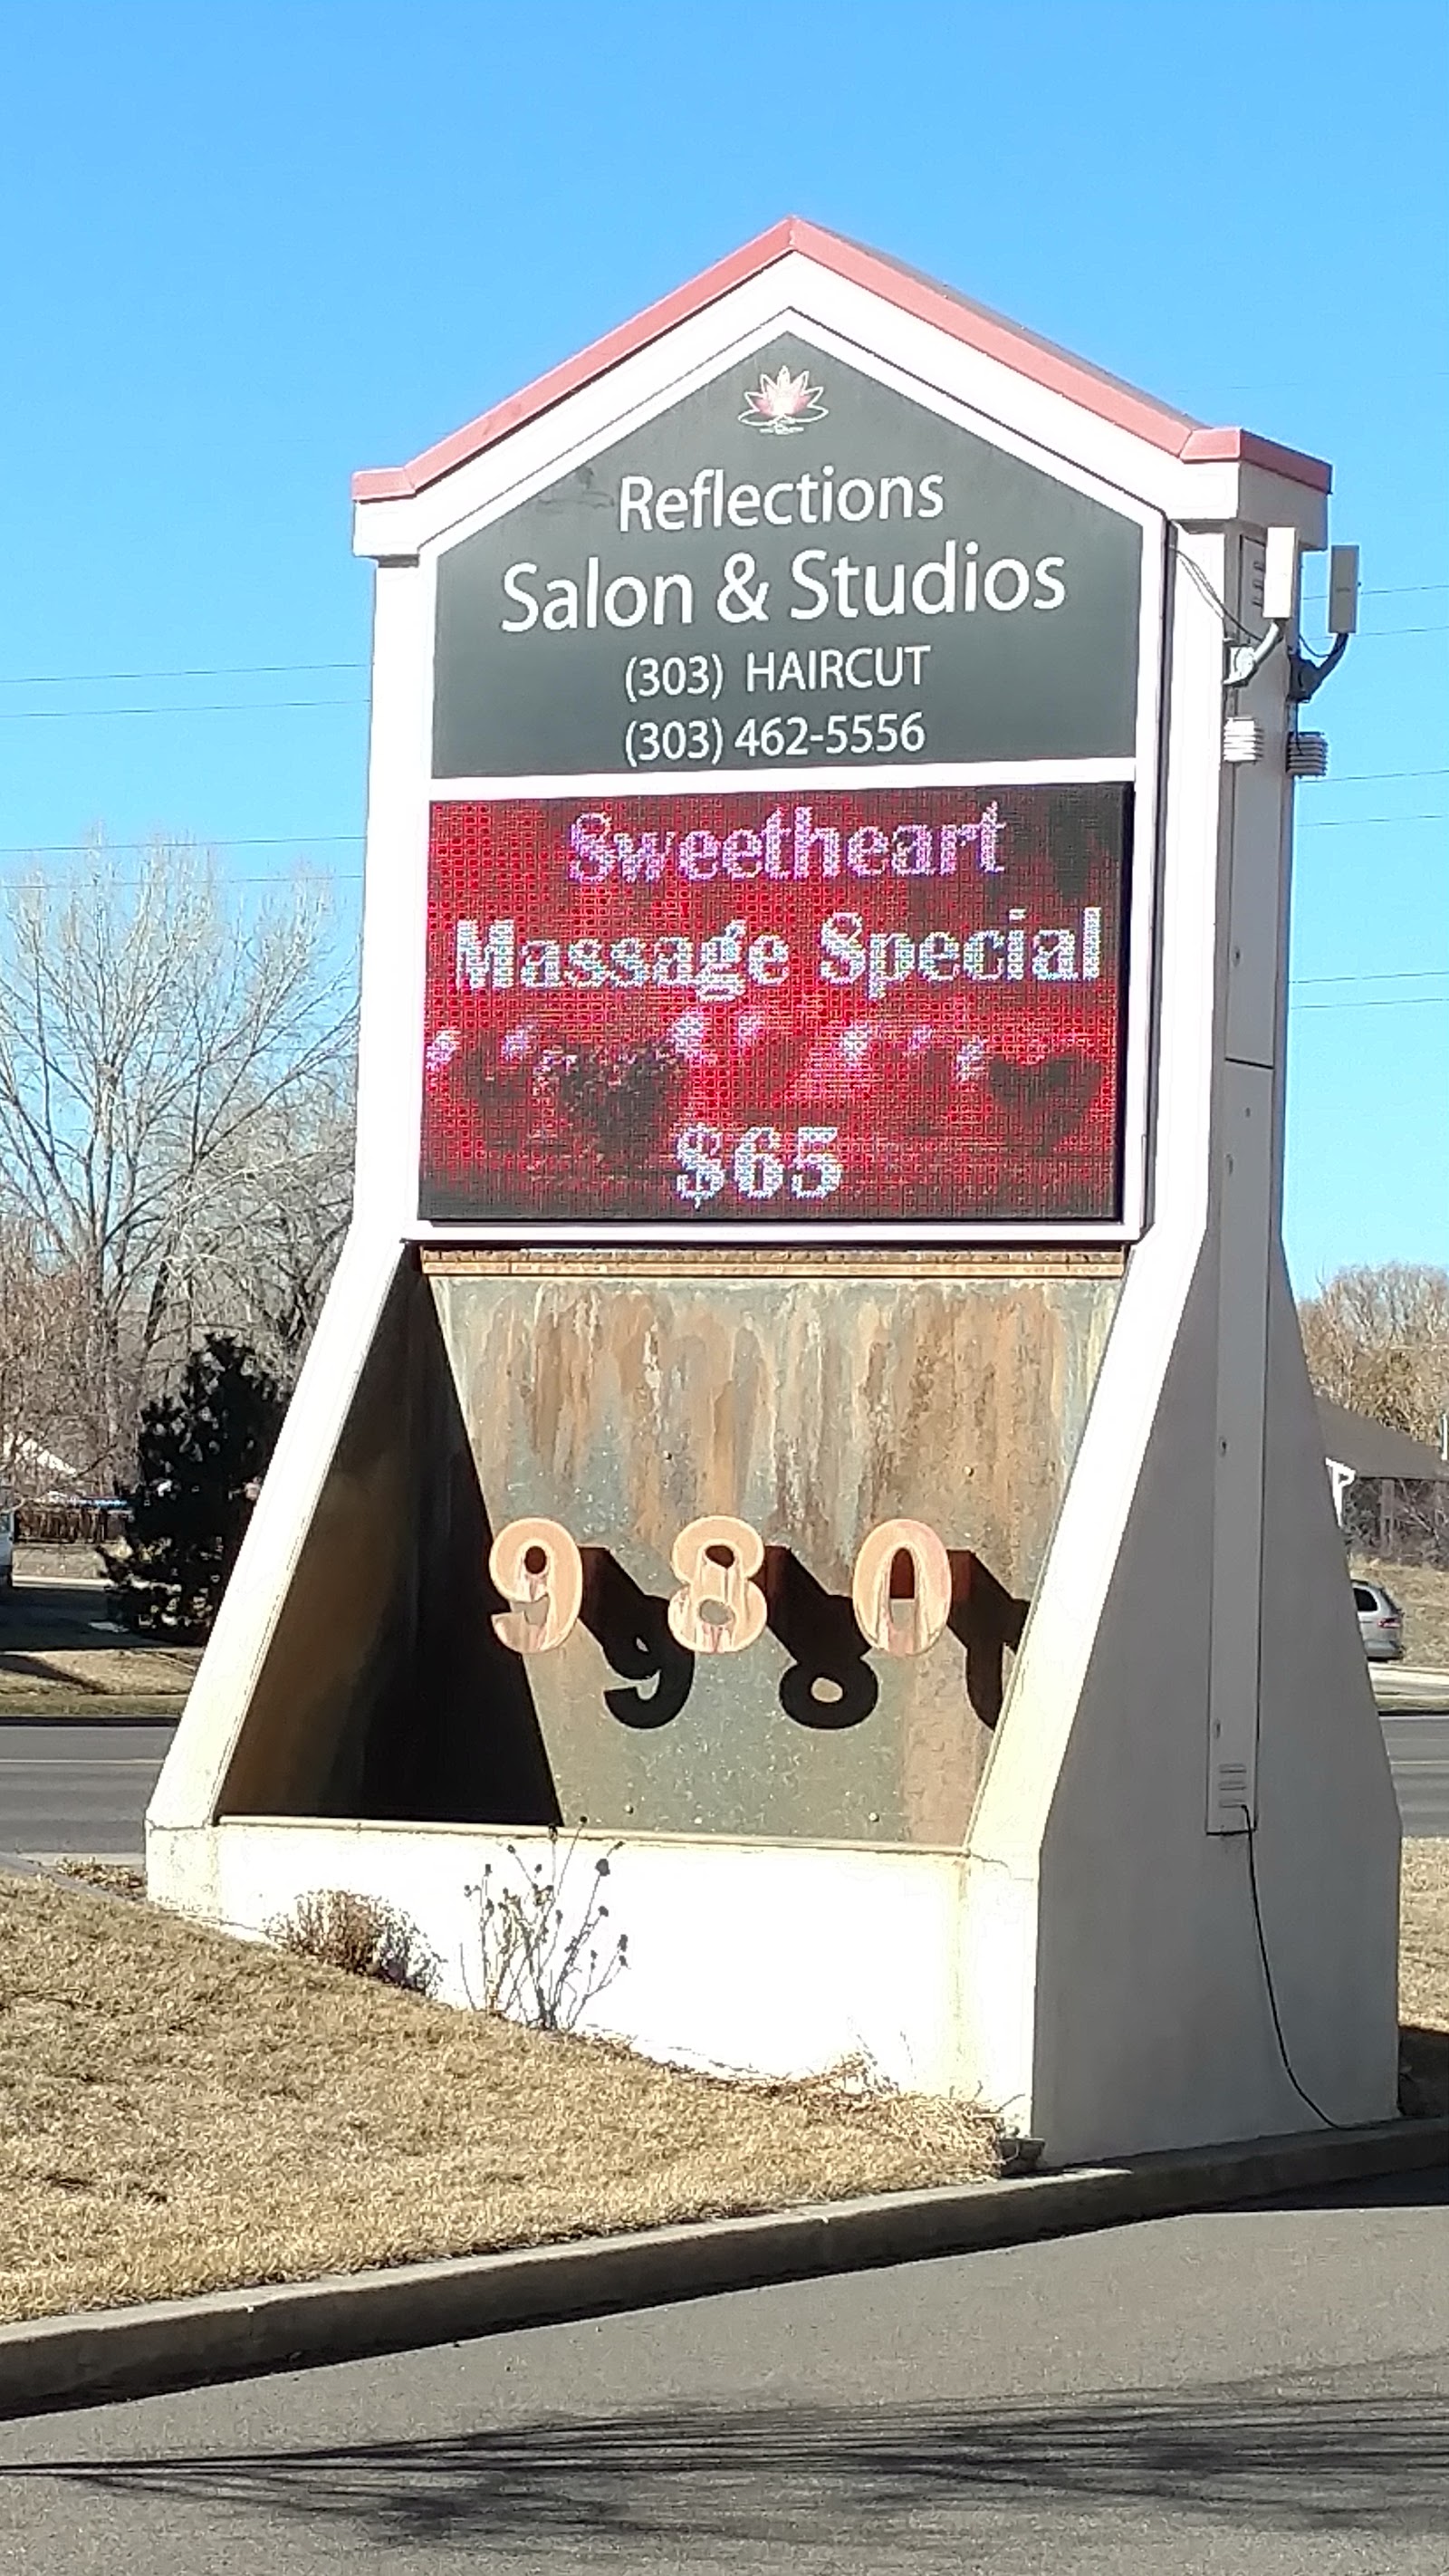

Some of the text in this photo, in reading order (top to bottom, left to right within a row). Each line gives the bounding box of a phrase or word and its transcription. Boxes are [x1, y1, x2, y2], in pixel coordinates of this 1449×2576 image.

[619, 465, 945, 533] Reflections
[501, 540, 1066, 633] Salon & Studios
[624, 645, 931, 702] (303) HAIRCUT
[624, 712, 925, 767] (303) 462-5556
[569, 802, 1005, 882] Sweetheart
[455, 907, 1102, 1001] Massage Special
[676, 1122, 843, 1207] $65
[489, 1515, 952, 1655] 980
